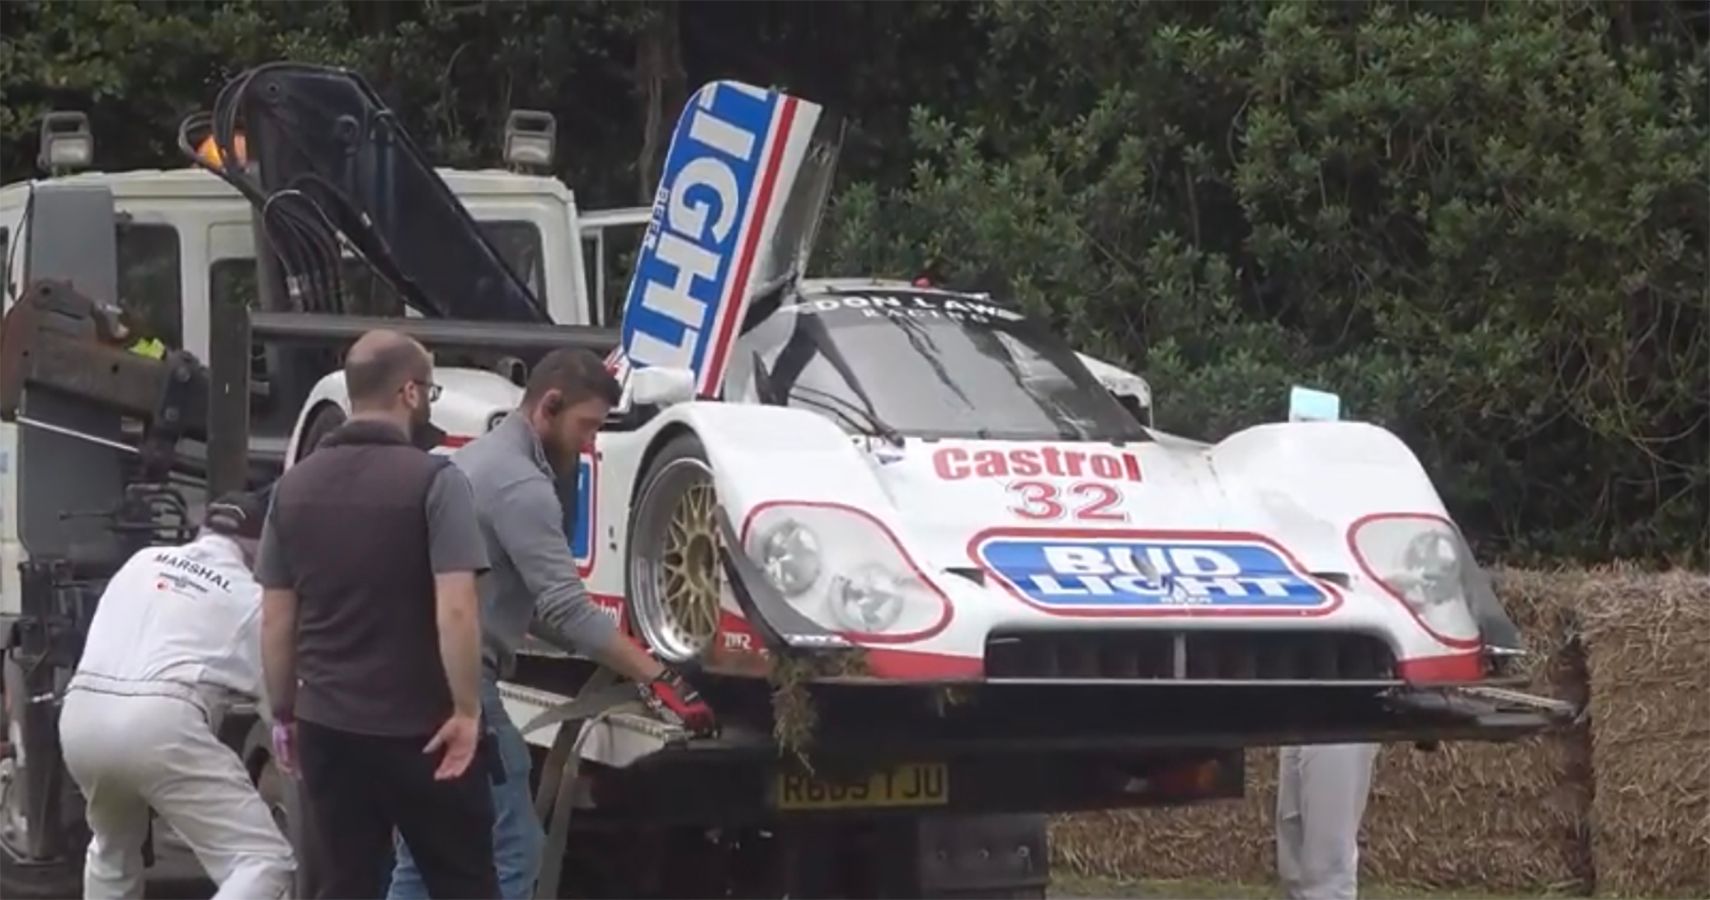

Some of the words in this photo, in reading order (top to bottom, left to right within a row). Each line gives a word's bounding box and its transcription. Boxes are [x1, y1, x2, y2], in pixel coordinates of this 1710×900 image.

[932, 447, 1142, 482] Castrol
[1005, 481, 1131, 522] 32
[154, 554, 232, 594] MARSHAL
[1042, 546, 1241, 577] BUD
[1029, 574, 1291, 597] LIGHT
